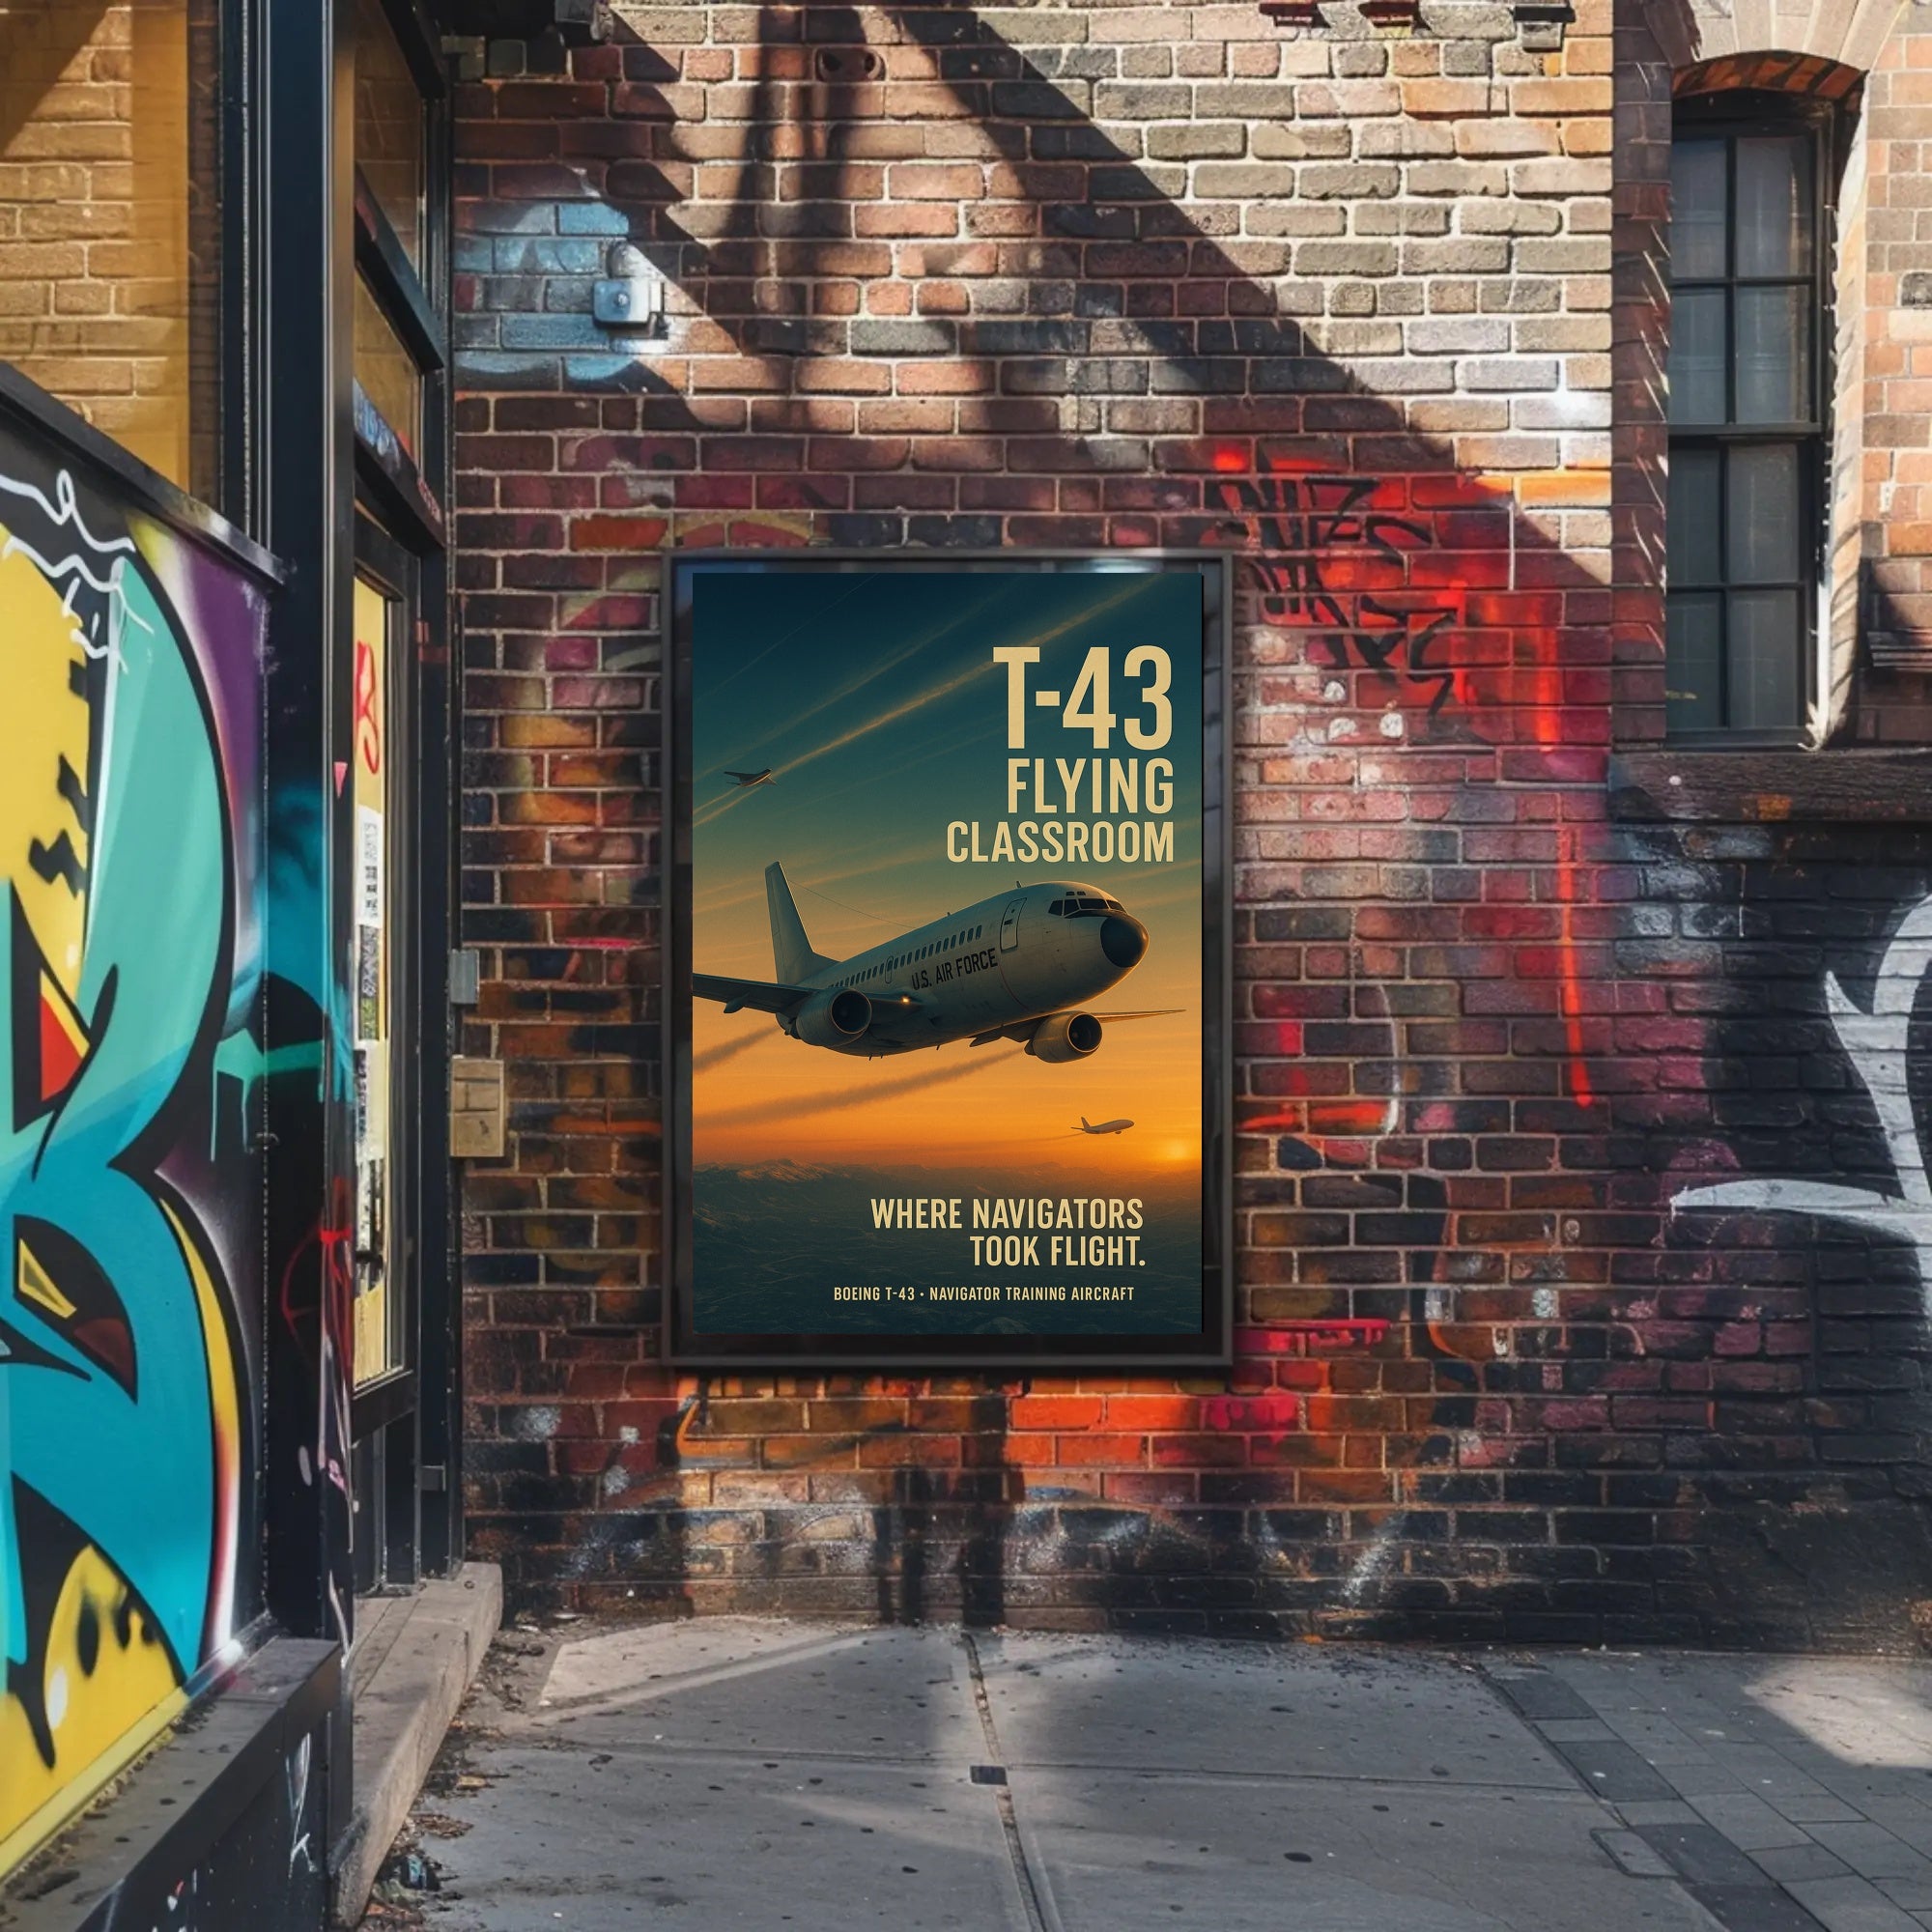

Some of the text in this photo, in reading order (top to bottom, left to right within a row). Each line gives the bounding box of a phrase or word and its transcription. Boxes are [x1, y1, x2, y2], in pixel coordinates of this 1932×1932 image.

[993, 645, 1173, 751] T-43
[1009, 757, 1174, 814] FLYING
[947, 820, 1174, 863] CLASSROOM
[912, 948, 998, 990] U.S. AIR FORCE
[871, 1198, 1144, 1230] WHERE NAVIGATORS
[970, 1236, 1146, 1266] TOOK FLIGHT.
[834, 1287, 1134, 1301] BOEING T-43 NAVIGATOR TRAINING AIRCRAFT
